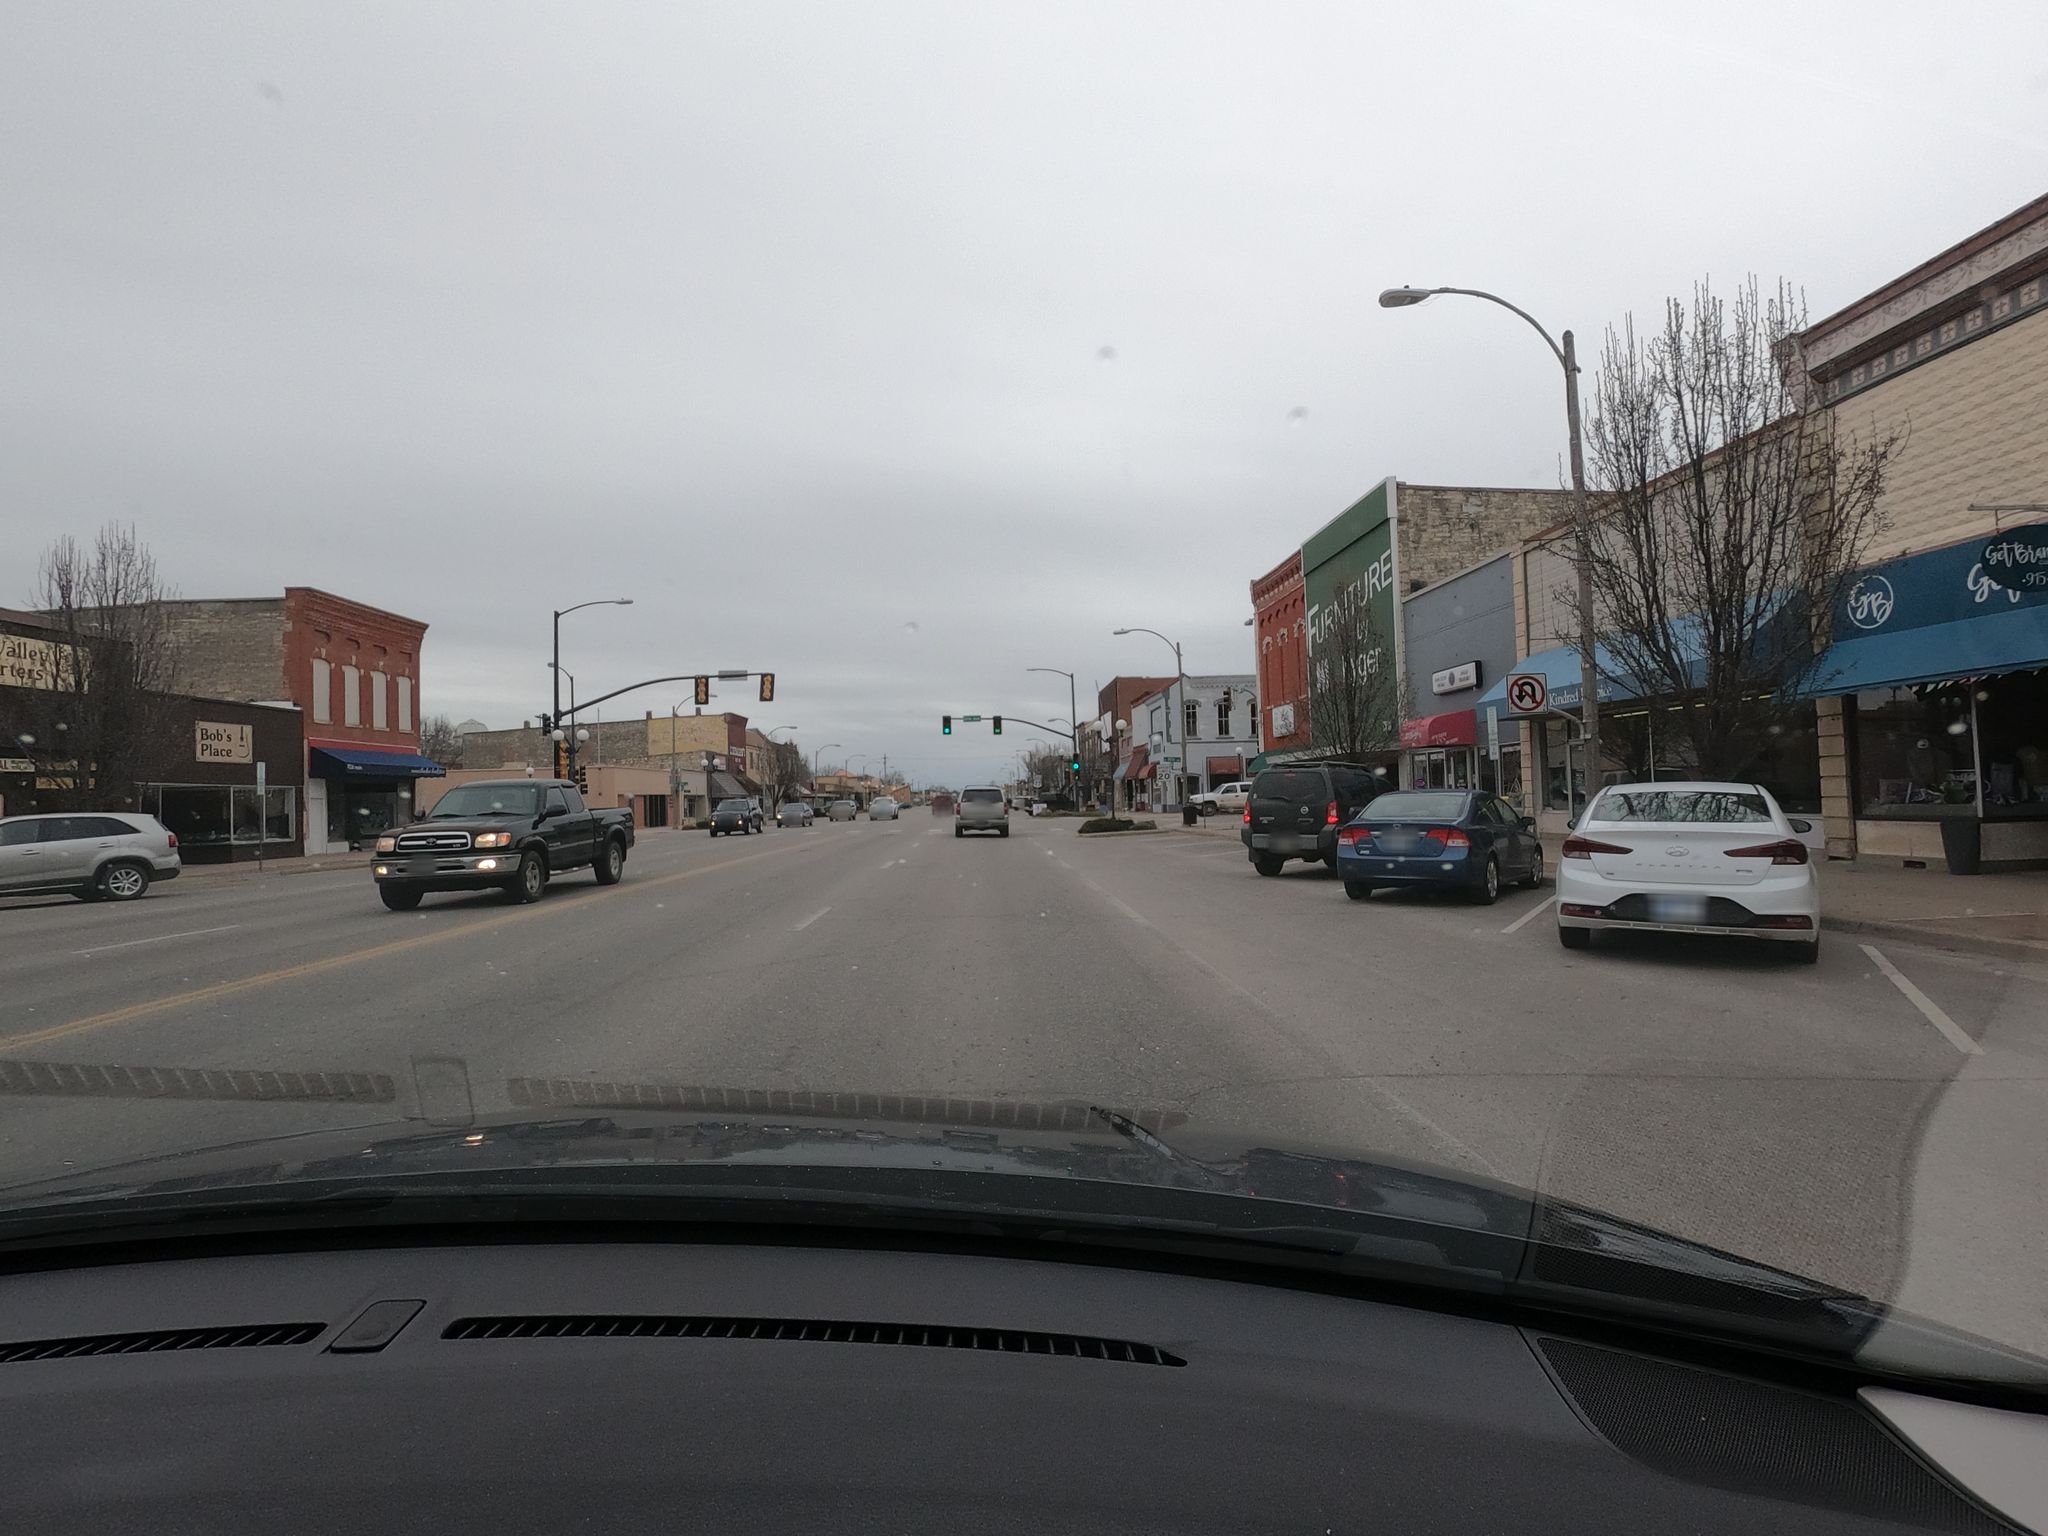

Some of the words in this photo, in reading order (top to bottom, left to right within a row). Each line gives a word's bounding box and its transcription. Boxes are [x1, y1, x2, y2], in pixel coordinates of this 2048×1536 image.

[1985, 542, 2013, 567] Get
[2014, 542, 2048, 564] Bra
[1307, 549, 1392, 657] FURNITURE
[1549, 687, 1579, 706] Kindred
[201, 728, 232, 742] Bob's
[201, 743, 232, 757] Place
